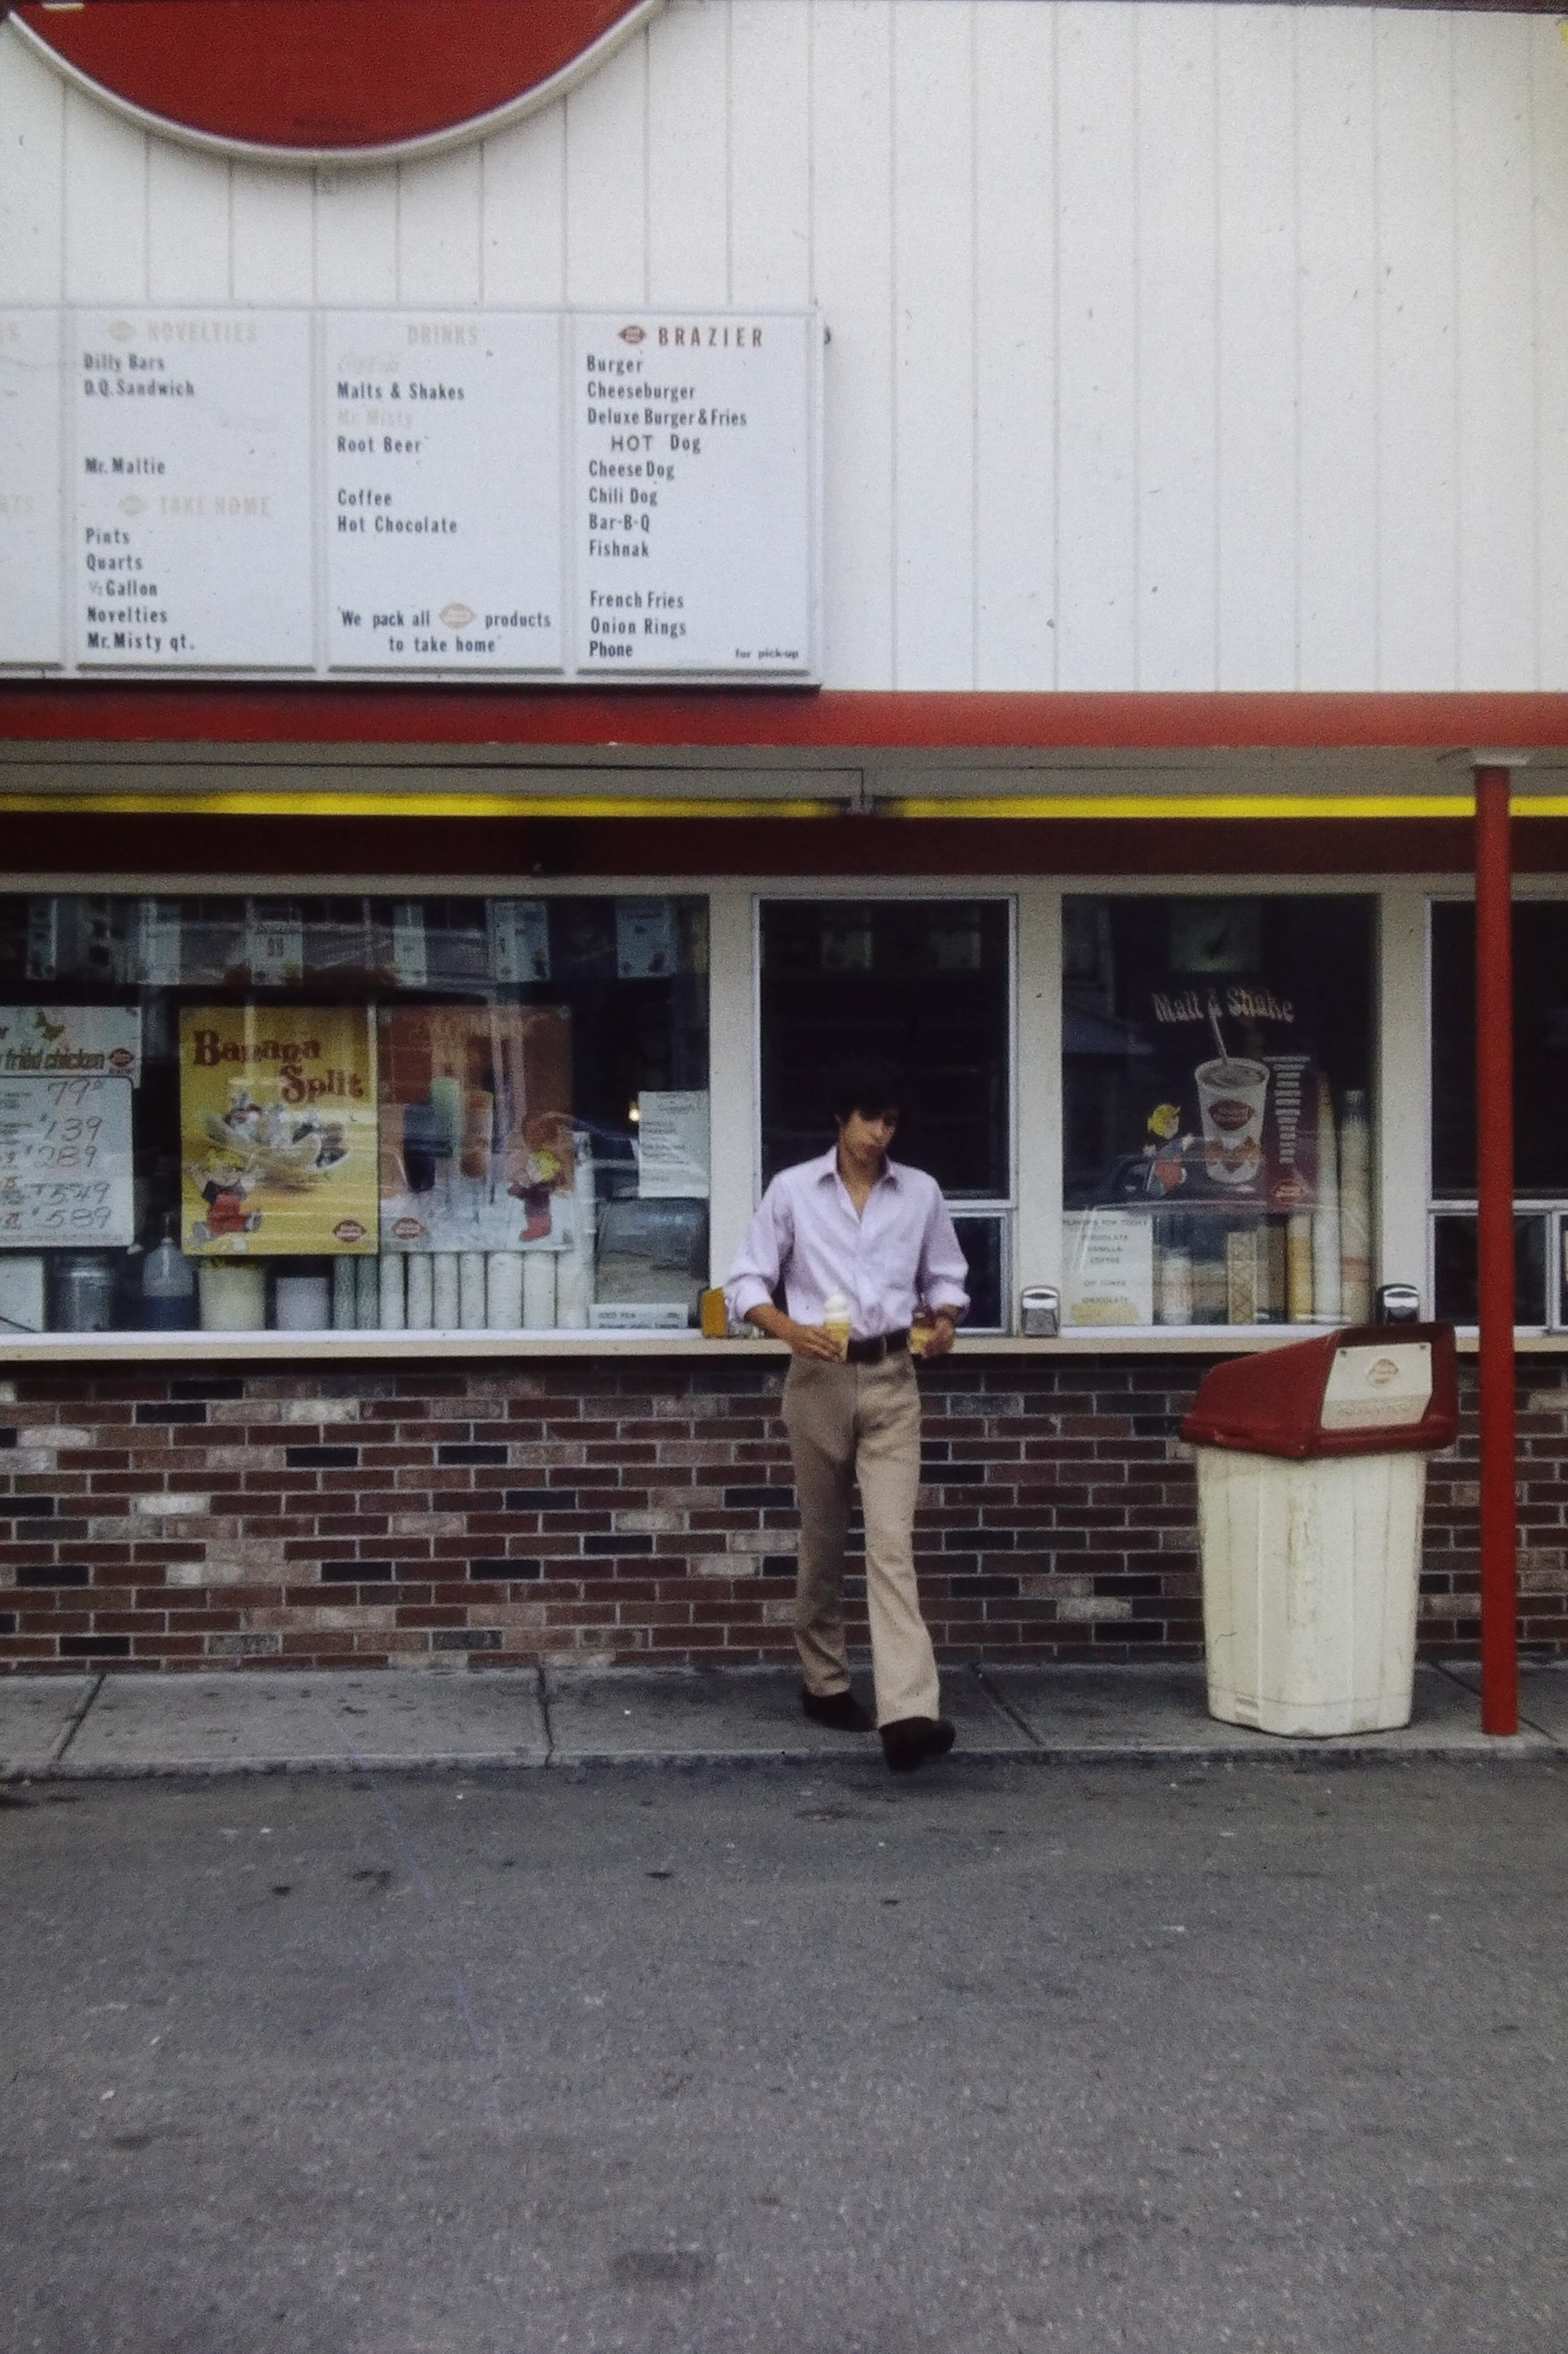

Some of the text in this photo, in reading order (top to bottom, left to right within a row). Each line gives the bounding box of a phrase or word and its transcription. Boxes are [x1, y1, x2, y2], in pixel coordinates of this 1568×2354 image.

[146, 320, 258, 343] NOVELTIES
[406, 324, 479, 346] DRINKS
[658, 326, 762, 347] BRAZIER
[83, 352, 165, 373] Dilly Bars
[586, 354, 642, 376] Burger
[116, 378, 195, 397] Sandwich
[337, 381, 465, 400] Malts & Shakes
[586, 380, 695, 403] Cheeseburger
[587, 407, 747, 429] Deluxe Burger & Fries
[337, 434, 420, 453] Root Beer
[611, 433, 701, 455] HOT Dog
[85, 457, 108, 474] Mr.
[588, 459, 675, 481] Cheese Dog
[337, 488, 392, 506] Coffee
[588, 486, 658, 507] Chili Dog
[337, 515, 457, 533] Hot Chocolate
[85, 527, 130, 544] Pints
[588, 539, 649, 558] Fishnak
[85, 552, 143, 572] Quarts
[105, 578, 158, 597] Gallon
[590, 589, 684, 609] French Fries
[87, 606, 167, 623] Novelties
[372, 611, 405, 630] pack
[411, 610, 430, 627] all
[485, 611, 551, 630] products
[590, 616, 687, 639] Onion Rings
[87, 632, 194, 652] Mr. Misty qt.
[388, 636, 404, 652] to
[414, 636, 447, 652] take
[589, 640, 633, 658] Phone
[1227, 986, 1295, 1023] Shake
[44, 1048, 105, 1069] chicken
[192, 1030, 321, 1067] Banana
[280, 1064, 364, 1103] Split
